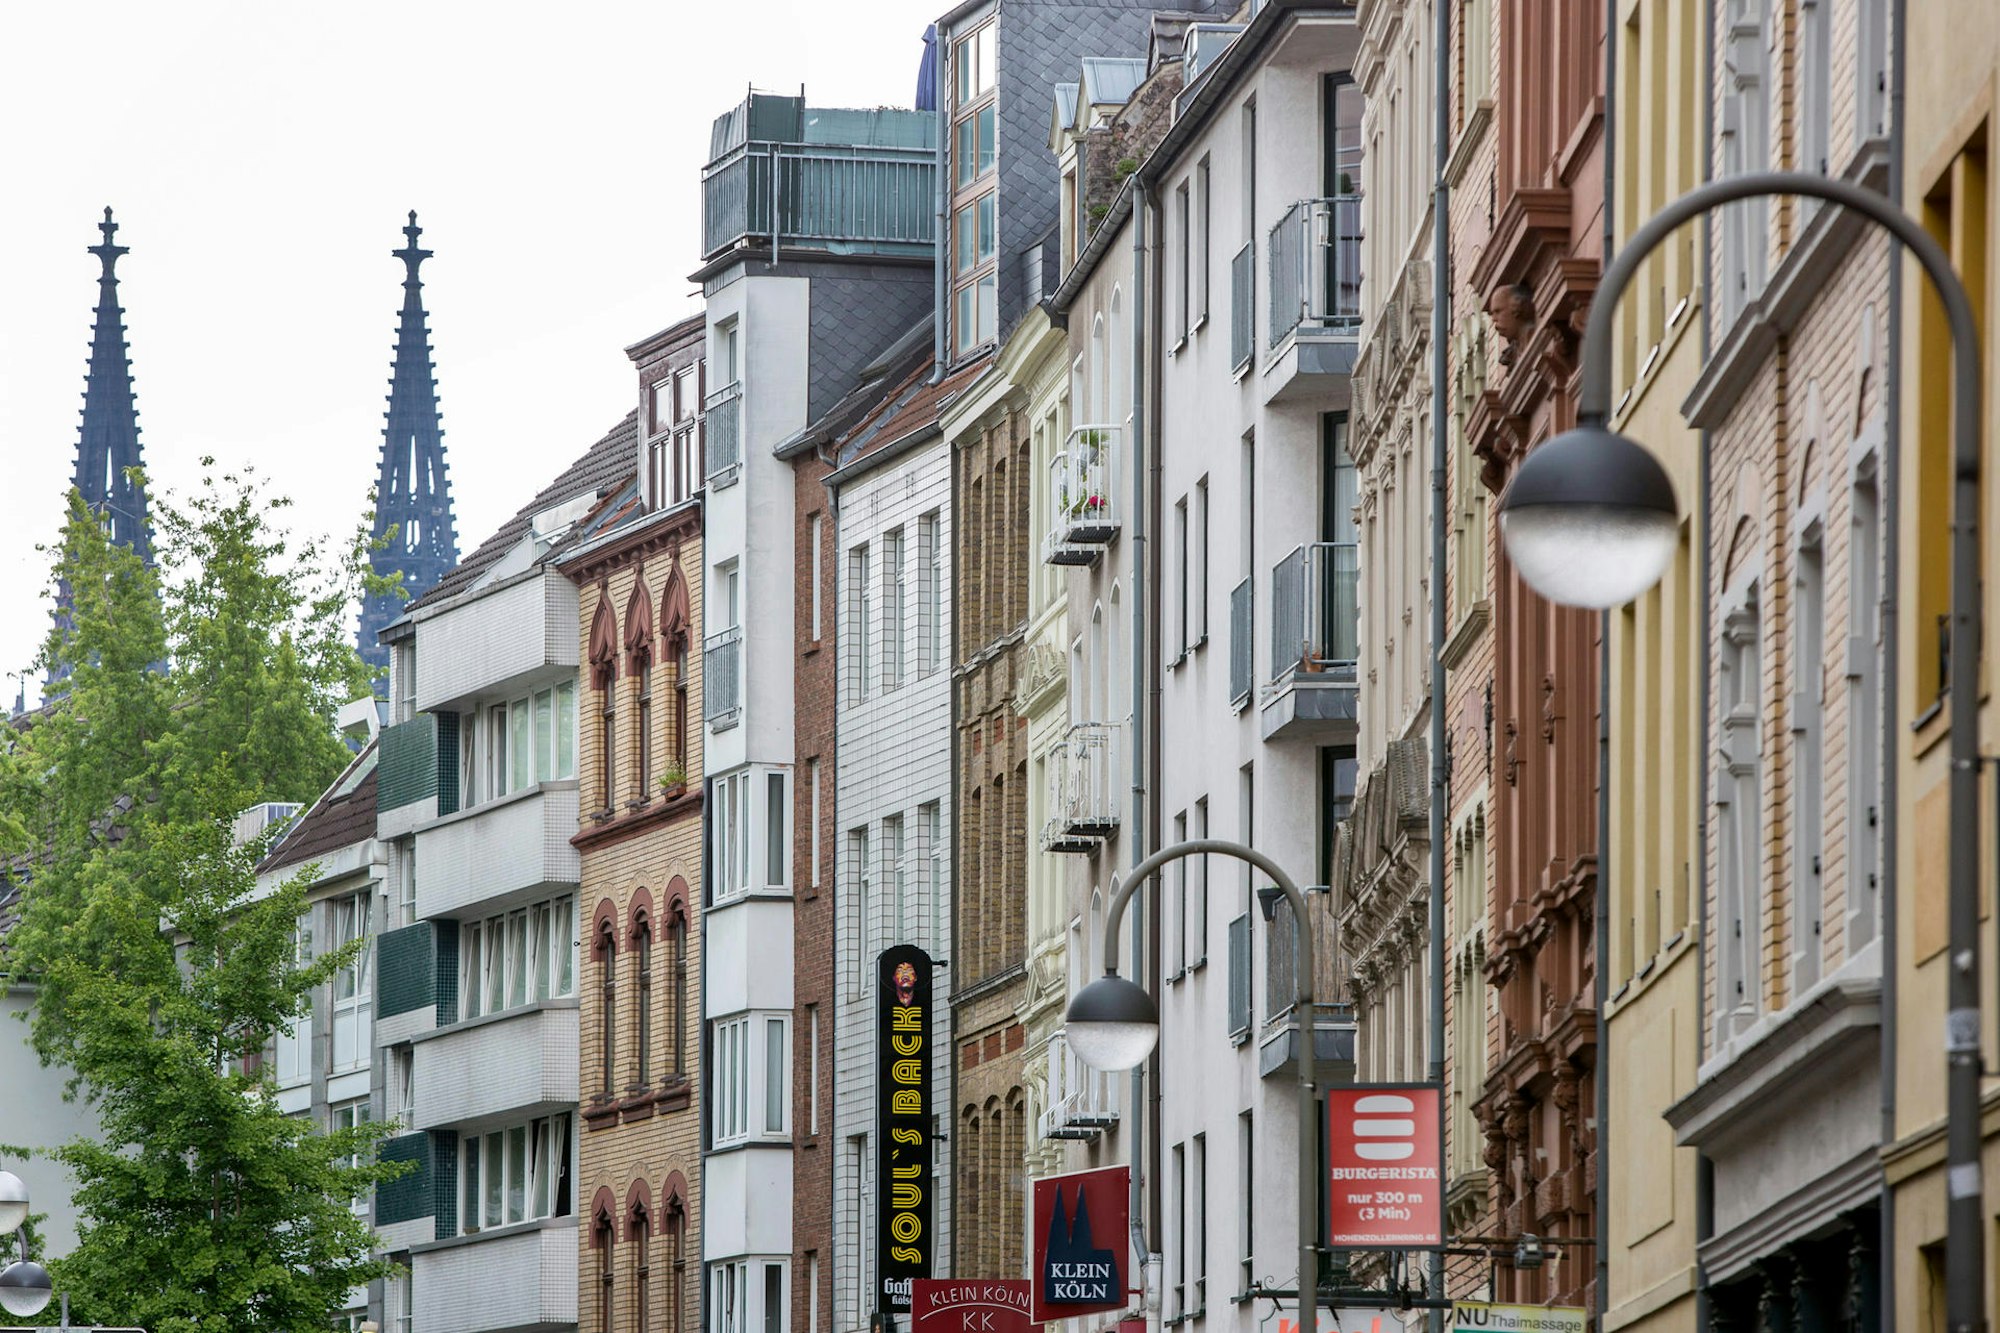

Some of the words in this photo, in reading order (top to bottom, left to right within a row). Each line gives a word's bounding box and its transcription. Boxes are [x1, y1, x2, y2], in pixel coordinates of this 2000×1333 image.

[892, 1006, 922, 1115] BACK
[1332, 1167, 1437, 1180] BURGERISTA
[1347, 1193, 1373, 1204] nur
[1375, 1191, 1405, 1204] 300
[1407, 1193, 1423, 1204] m
[1358, 1207, 1375, 1221] (3
[1378, 1206, 1411, 1221] Min)
[1051, 1263, 1111, 1279] KLEIN
[929, 1286, 977, 1307] KLEIN
[983, 1285, 1030, 1308] KÖLN
[1054, 1280, 1107, 1299] KÖLN
[1457, 1307, 1489, 1326] NU
[1490, 1314, 1582, 1333] Thaimassage
